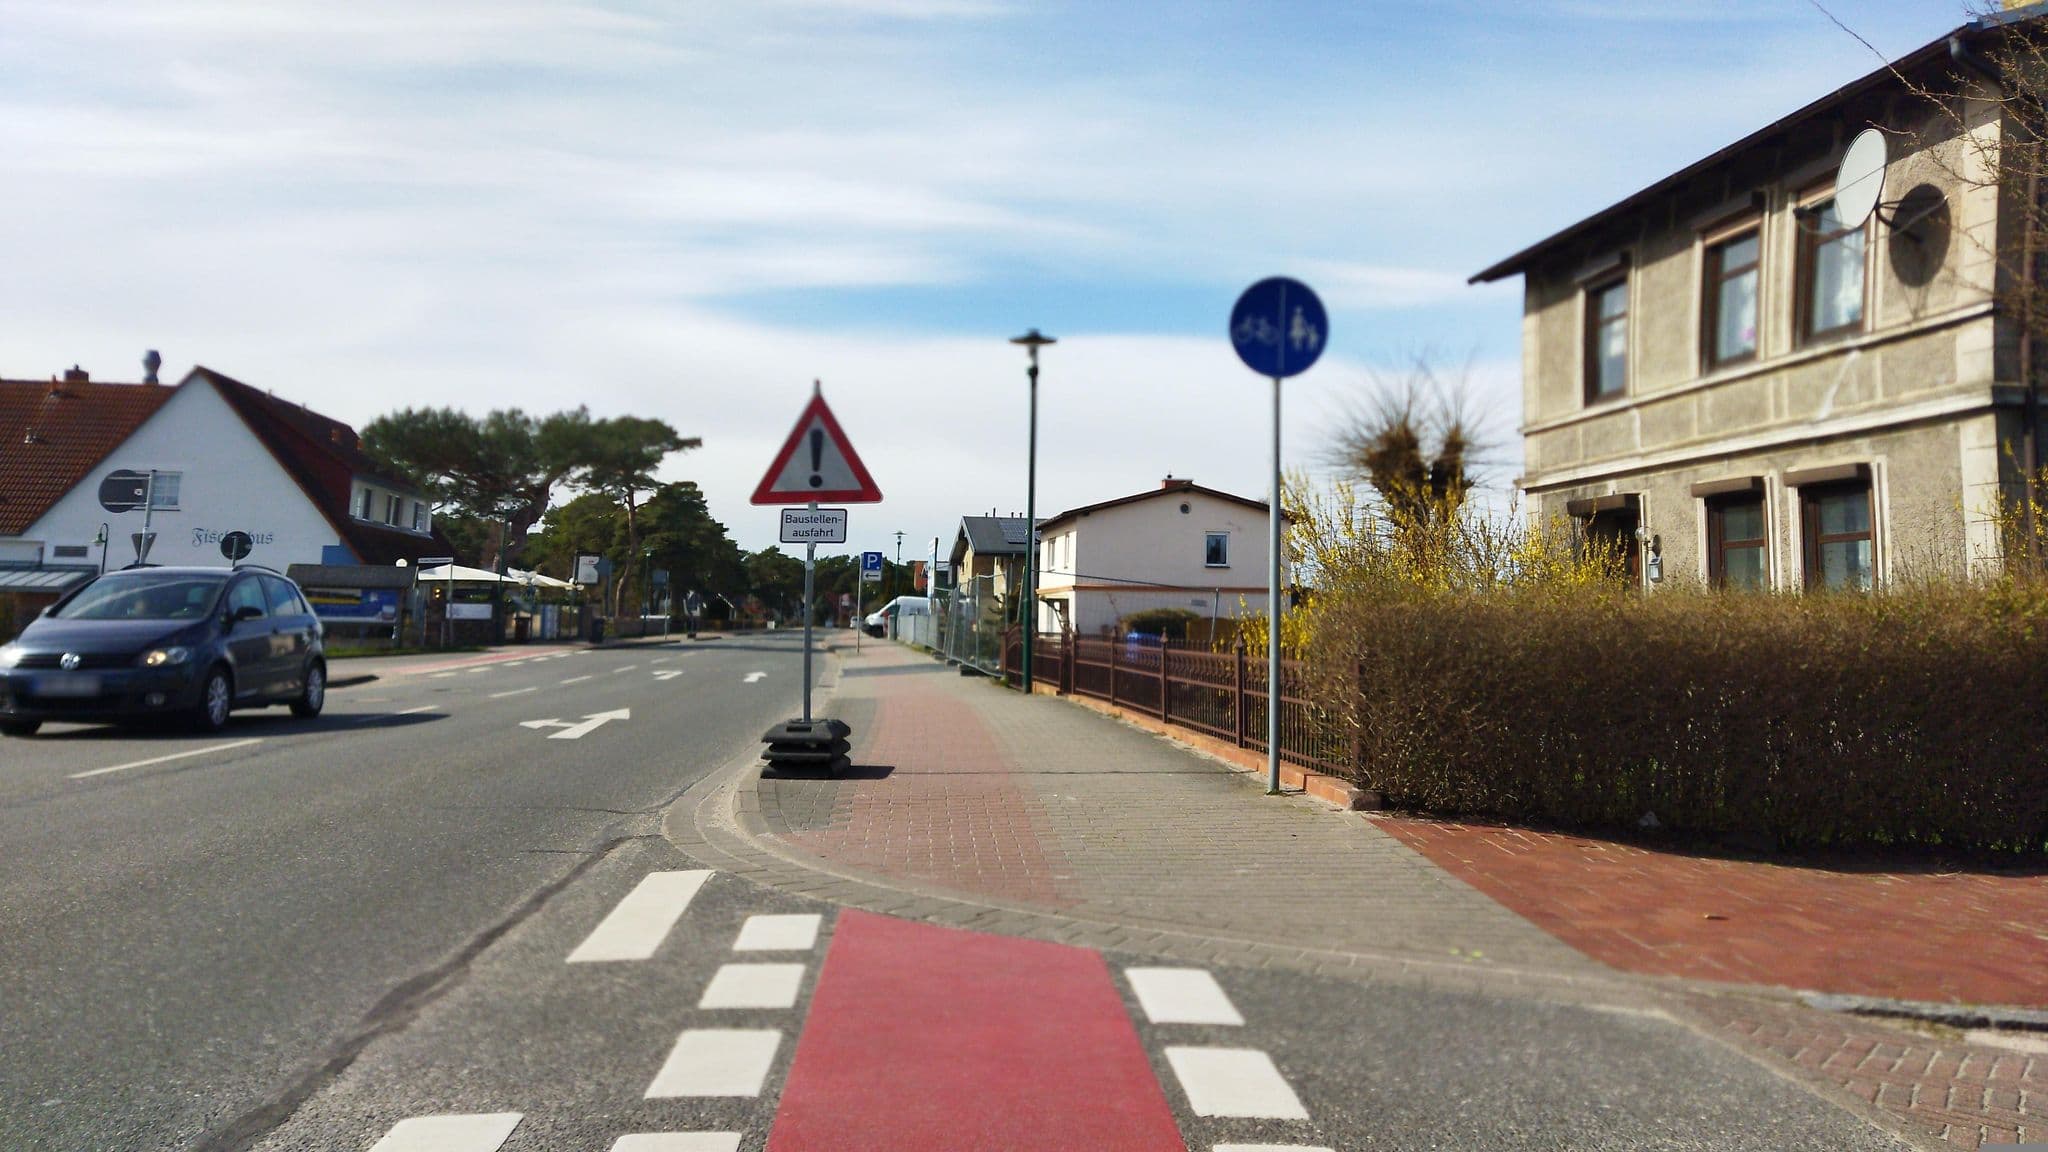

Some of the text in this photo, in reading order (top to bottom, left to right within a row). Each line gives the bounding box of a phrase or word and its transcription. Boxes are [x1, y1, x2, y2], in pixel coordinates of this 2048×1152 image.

[785, 514, 842, 524] Baustellen-
[792, 527, 834, 537] ausfahrt
[867, 553, 878, 569] P
